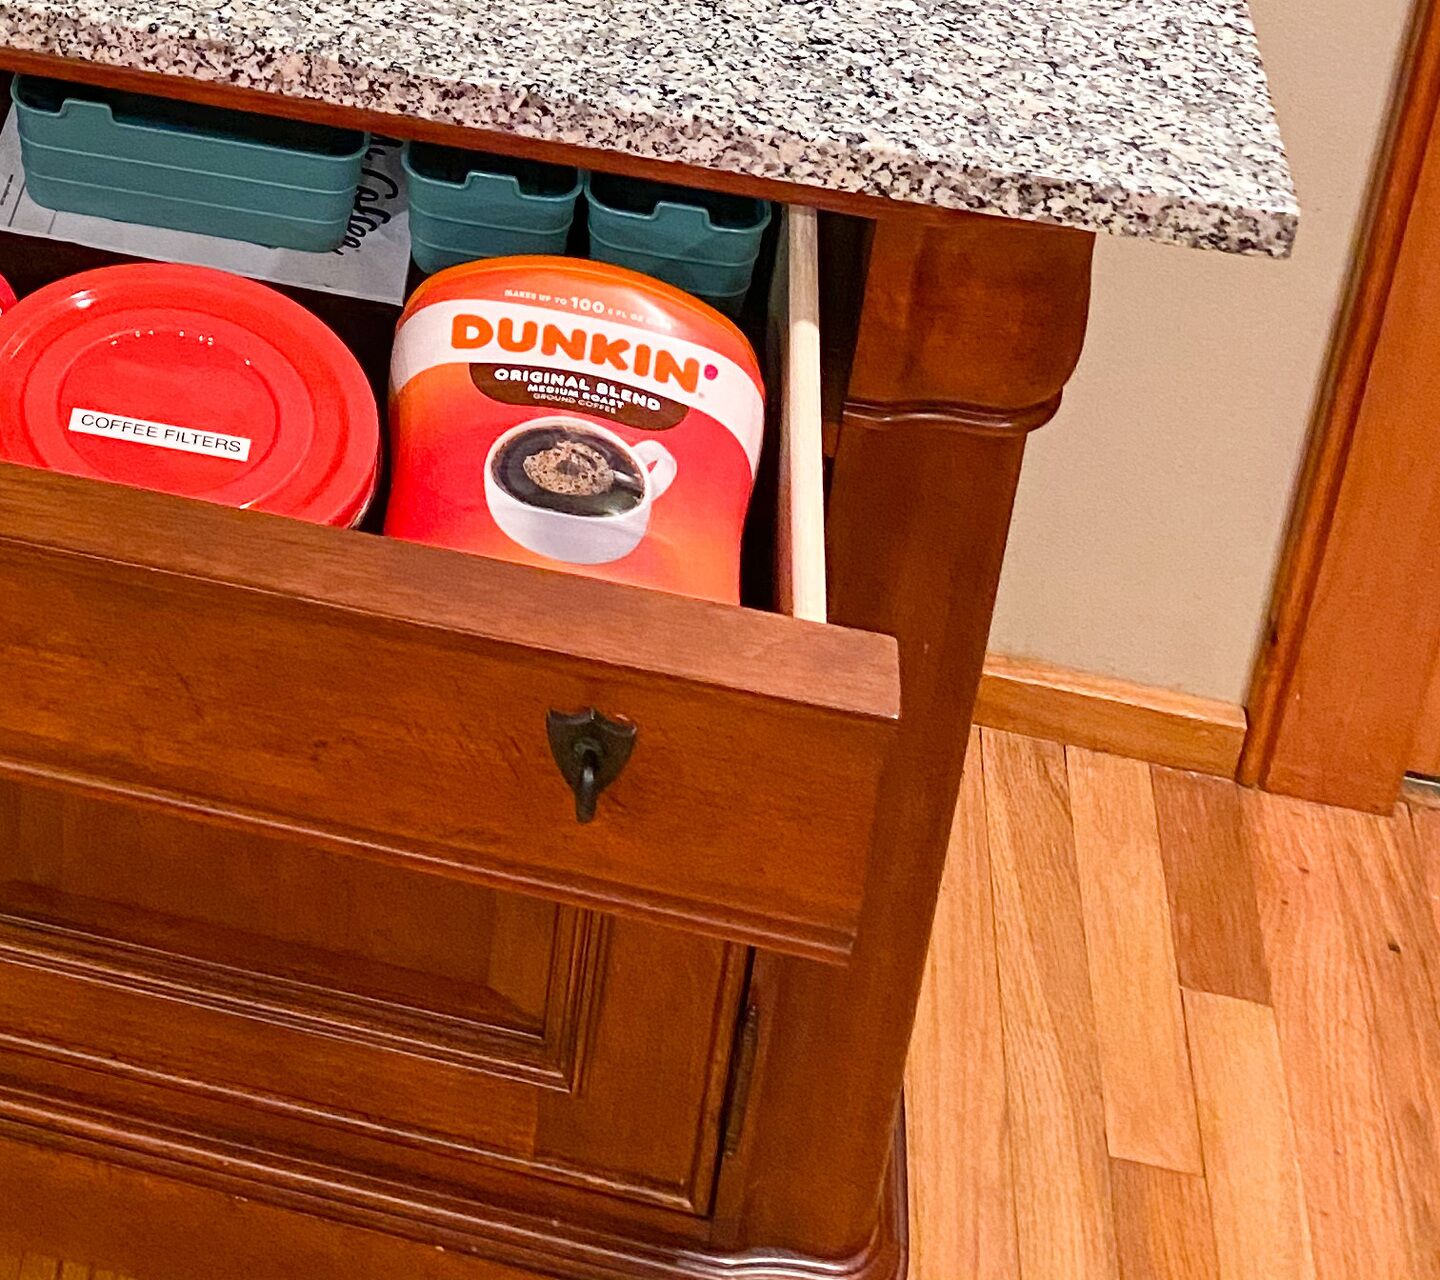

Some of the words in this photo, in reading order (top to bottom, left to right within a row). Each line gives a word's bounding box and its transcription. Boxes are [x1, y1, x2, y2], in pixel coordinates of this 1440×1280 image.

[504, 290, 537, 300] MAKES
[539, 294, 551, 302] UP
[554, 297, 568, 306] TO
[570, 296, 605, 315] 100
[493, 368, 590, 391] ORIGINAL
[596, 382, 661, 411] BLEND
[527, 383, 579, 398] MEDIUM
[582, 392, 625, 409] ROAST
[533, 392, 577, 404] GROUND
[577, 399, 616, 415] COFFEE
[81, 414, 159, 438] COFFEE
[164, 429, 241, 453] FILTERS
